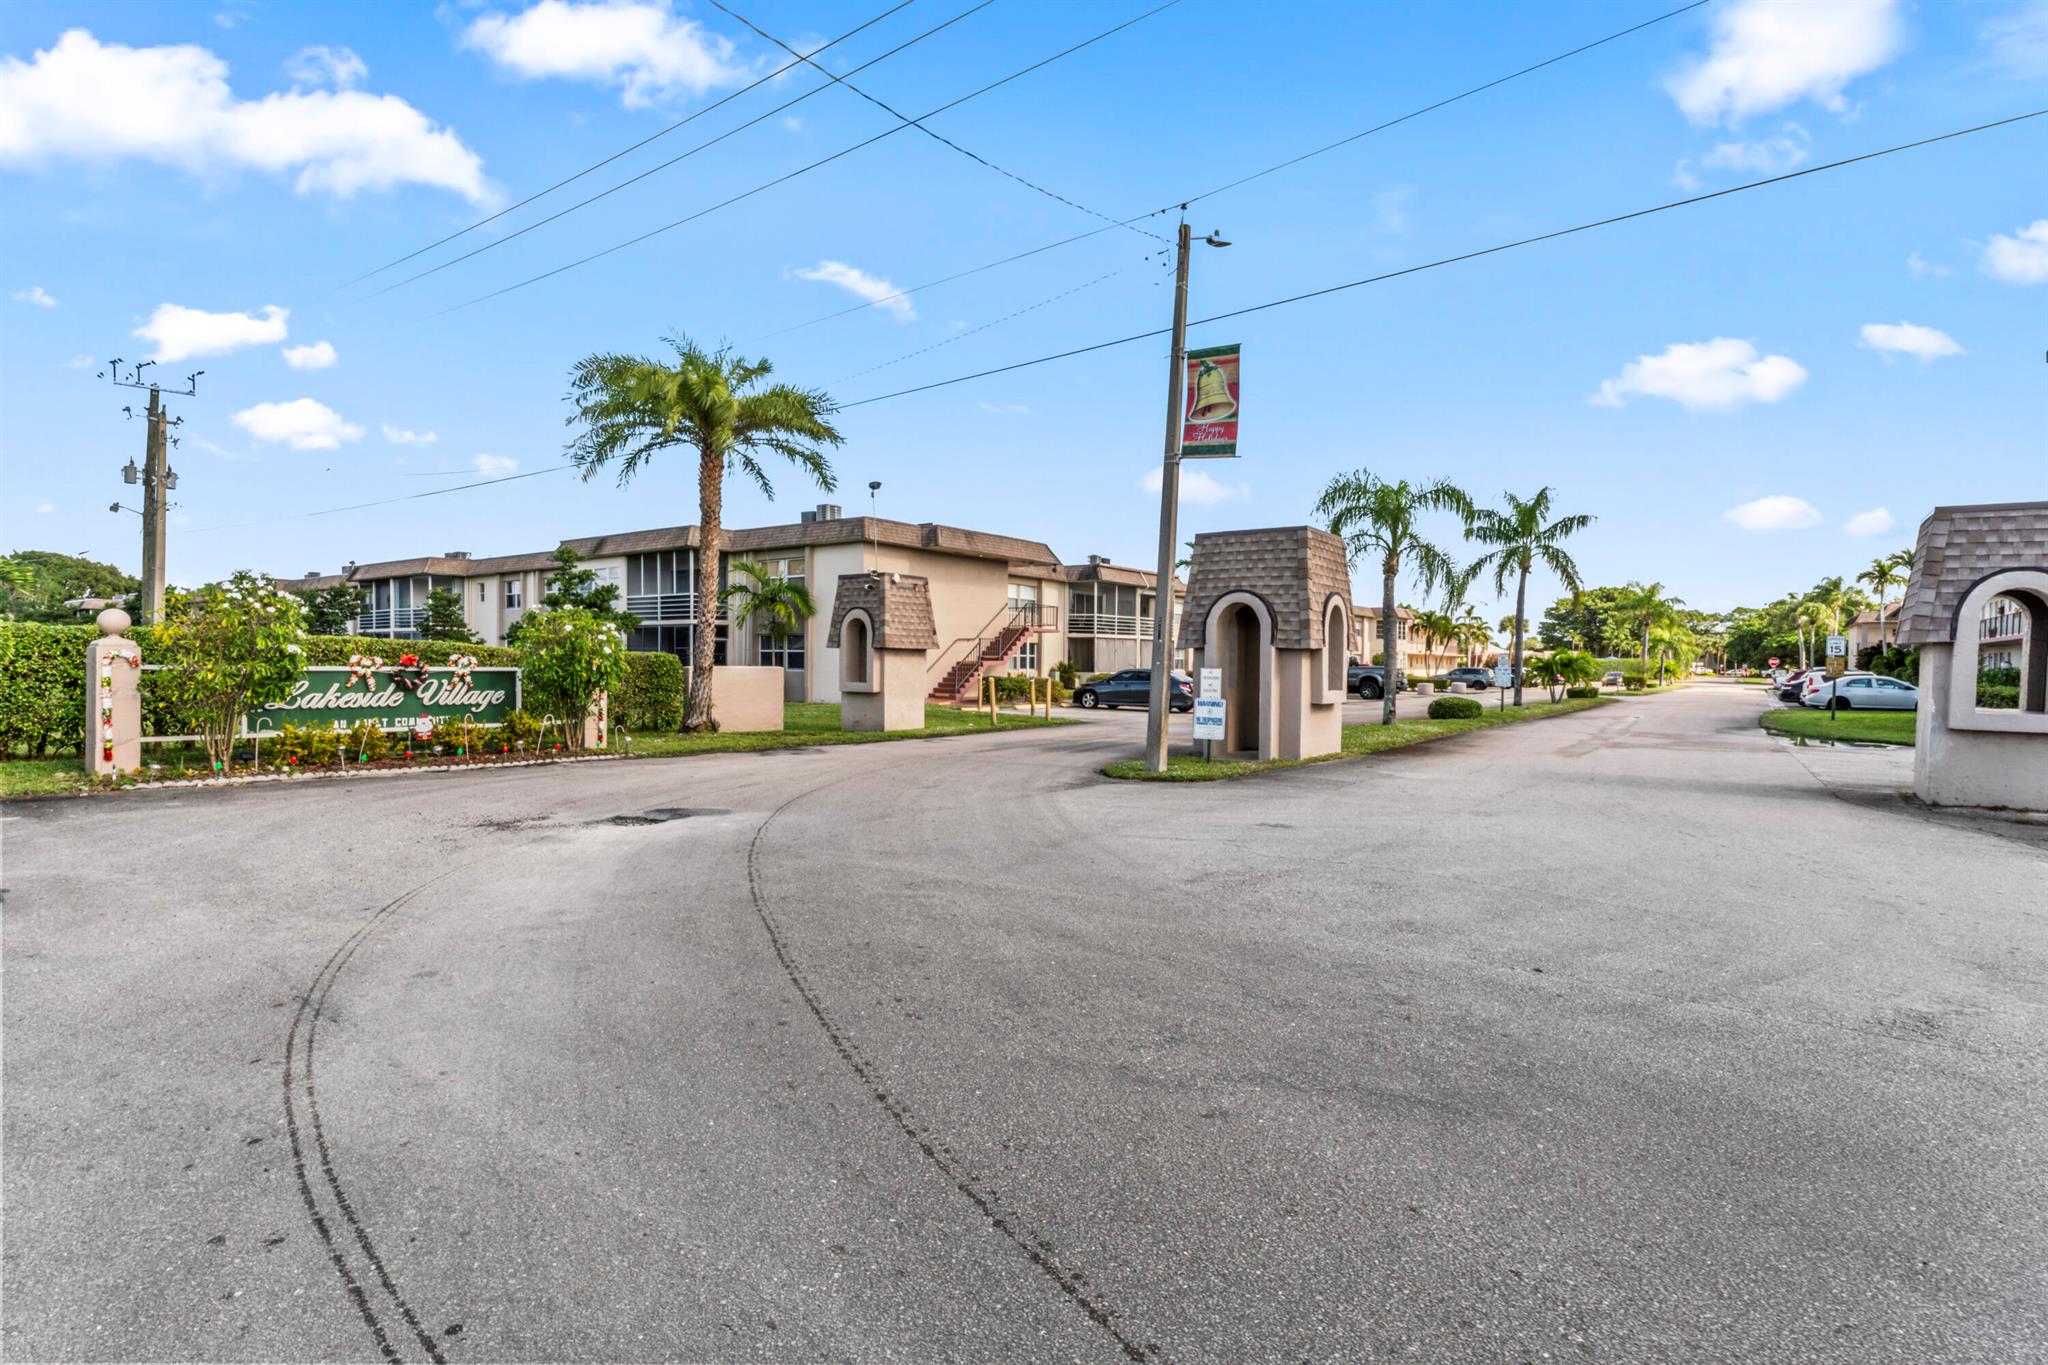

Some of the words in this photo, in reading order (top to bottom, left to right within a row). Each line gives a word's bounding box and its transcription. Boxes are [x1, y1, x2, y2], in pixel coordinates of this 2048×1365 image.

[1197, 423, 1225, 434] Happy
[1830, 645, 1842, 654] 15
[263, 680, 405, 710] Lakeside
[416, 678, 506, 713] Village
[333, 719, 347, 729] AN
